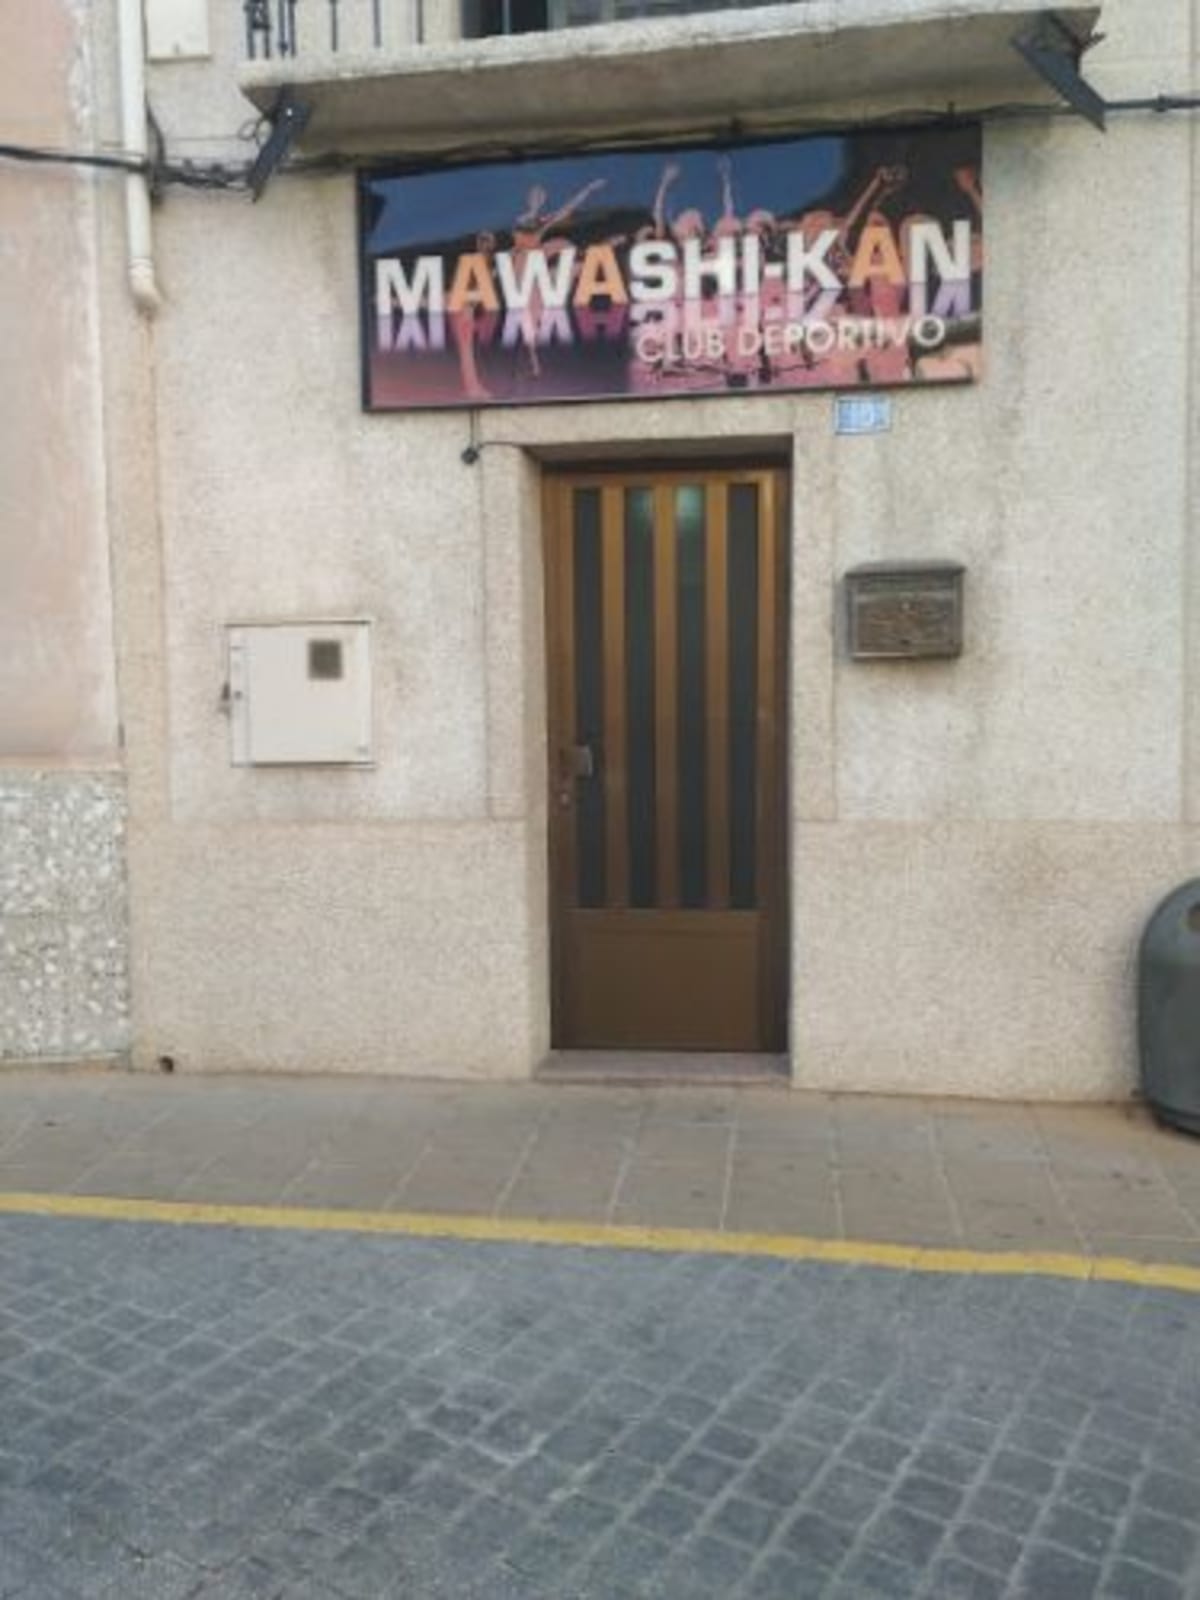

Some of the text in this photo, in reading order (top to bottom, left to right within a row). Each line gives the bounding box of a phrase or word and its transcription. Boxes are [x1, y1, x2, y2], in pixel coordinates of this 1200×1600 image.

[375, 220, 971, 316] MAWASHI-KAN
[636, 315, 946, 364] CLUB DEPORTIVO
